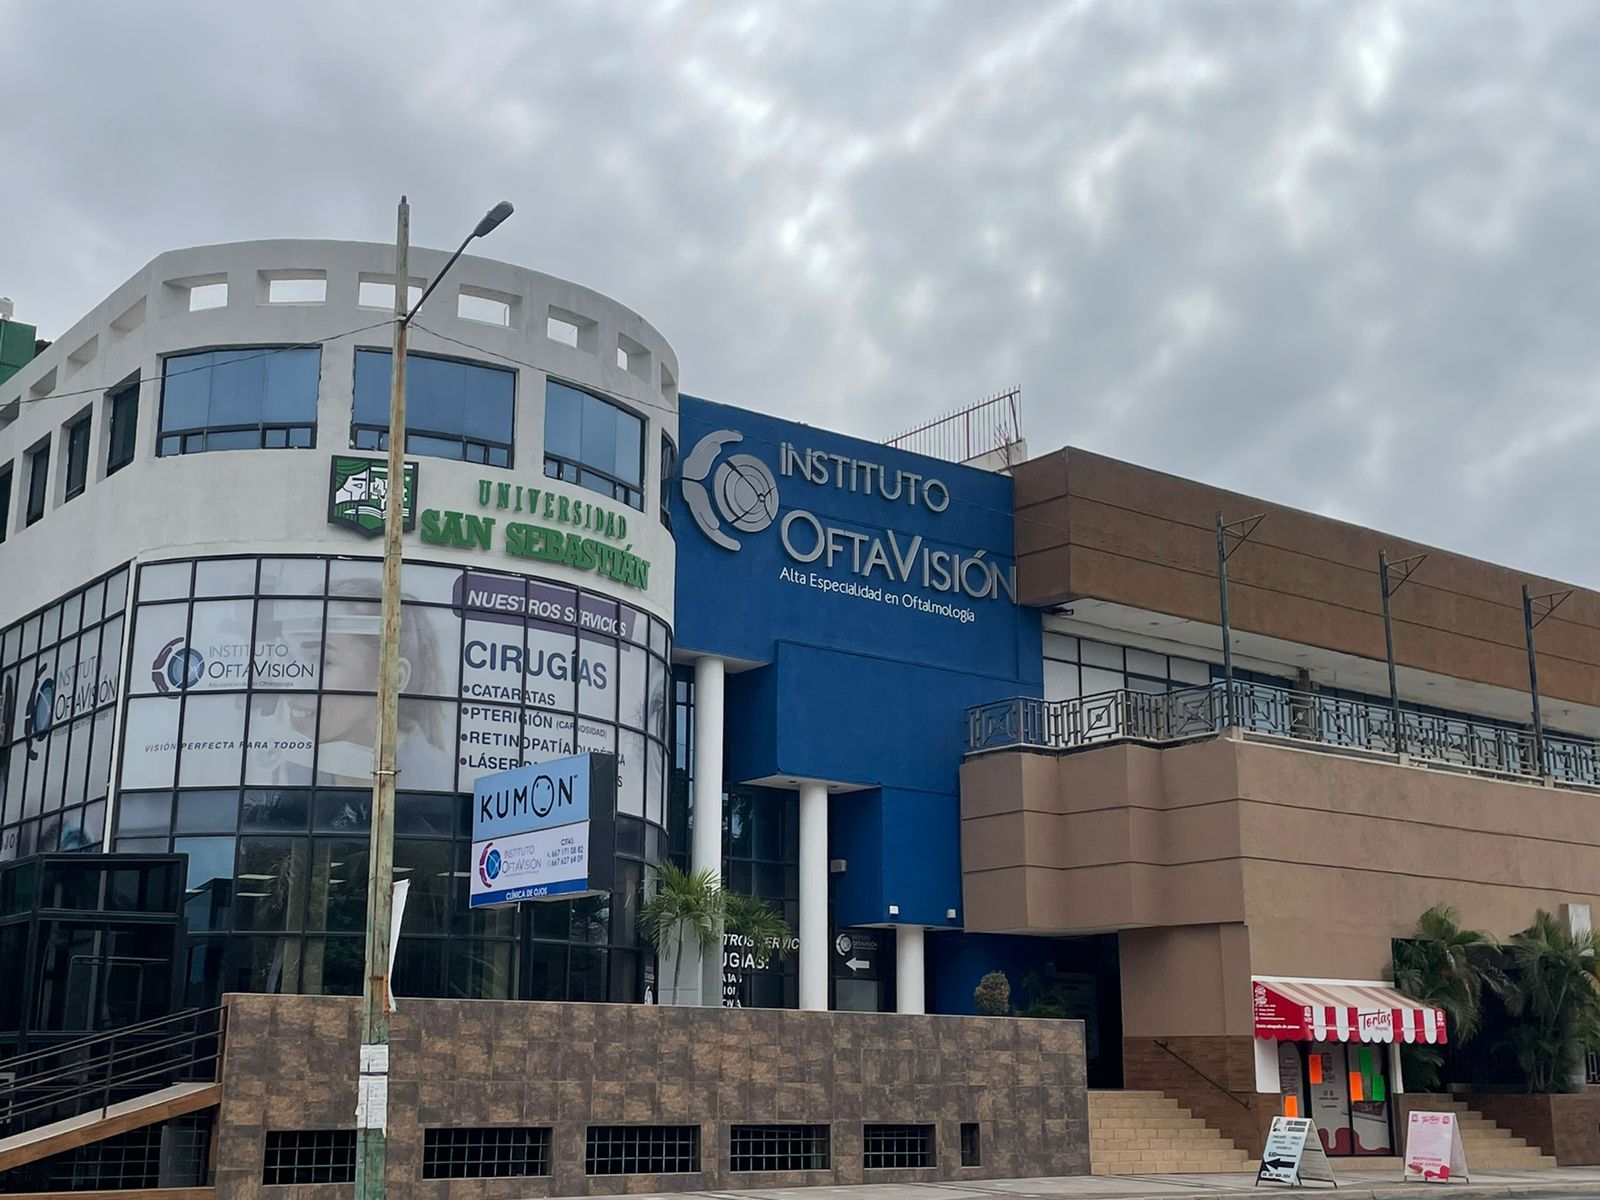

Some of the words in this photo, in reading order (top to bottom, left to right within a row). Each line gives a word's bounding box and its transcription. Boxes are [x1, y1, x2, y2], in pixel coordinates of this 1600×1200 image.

[779, 442, 950, 514] INSTITUTO
[478, 479, 628, 541] UNIVERSIDAD
[420, 508, 496, 550] SAN
[505, 521, 651, 591] SEBASTIÁN
[468, 590, 561, 620] NUESTROS
[779, 567, 807, 585] Alta
[809, 573, 882, 602] Especialidad
[884, 594, 899, 605] en
[902, 593, 976, 623] Oftalmología
[207, 643, 289, 658] INSTITUTO
[464, 640, 608, 690] CIRUGÍAS
[472, 684, 556, 706] CATARATAS
[556, 720, 607, 739] (CAROSIDAD)
[145, 741, 177, 752] VISIÓN
[180, 741, 235, 750] PERFECTA
[274, 741, 313, 750] TODOS
[469, 731, 571, 755] RETINOPATÍA
[480, 774, 573, 823] KUMON
[504, 845, 535, 859] INSTITUTO
[526, 888, 534, 898] DE
[1358, 1008, 1391, 1031] Tortas
